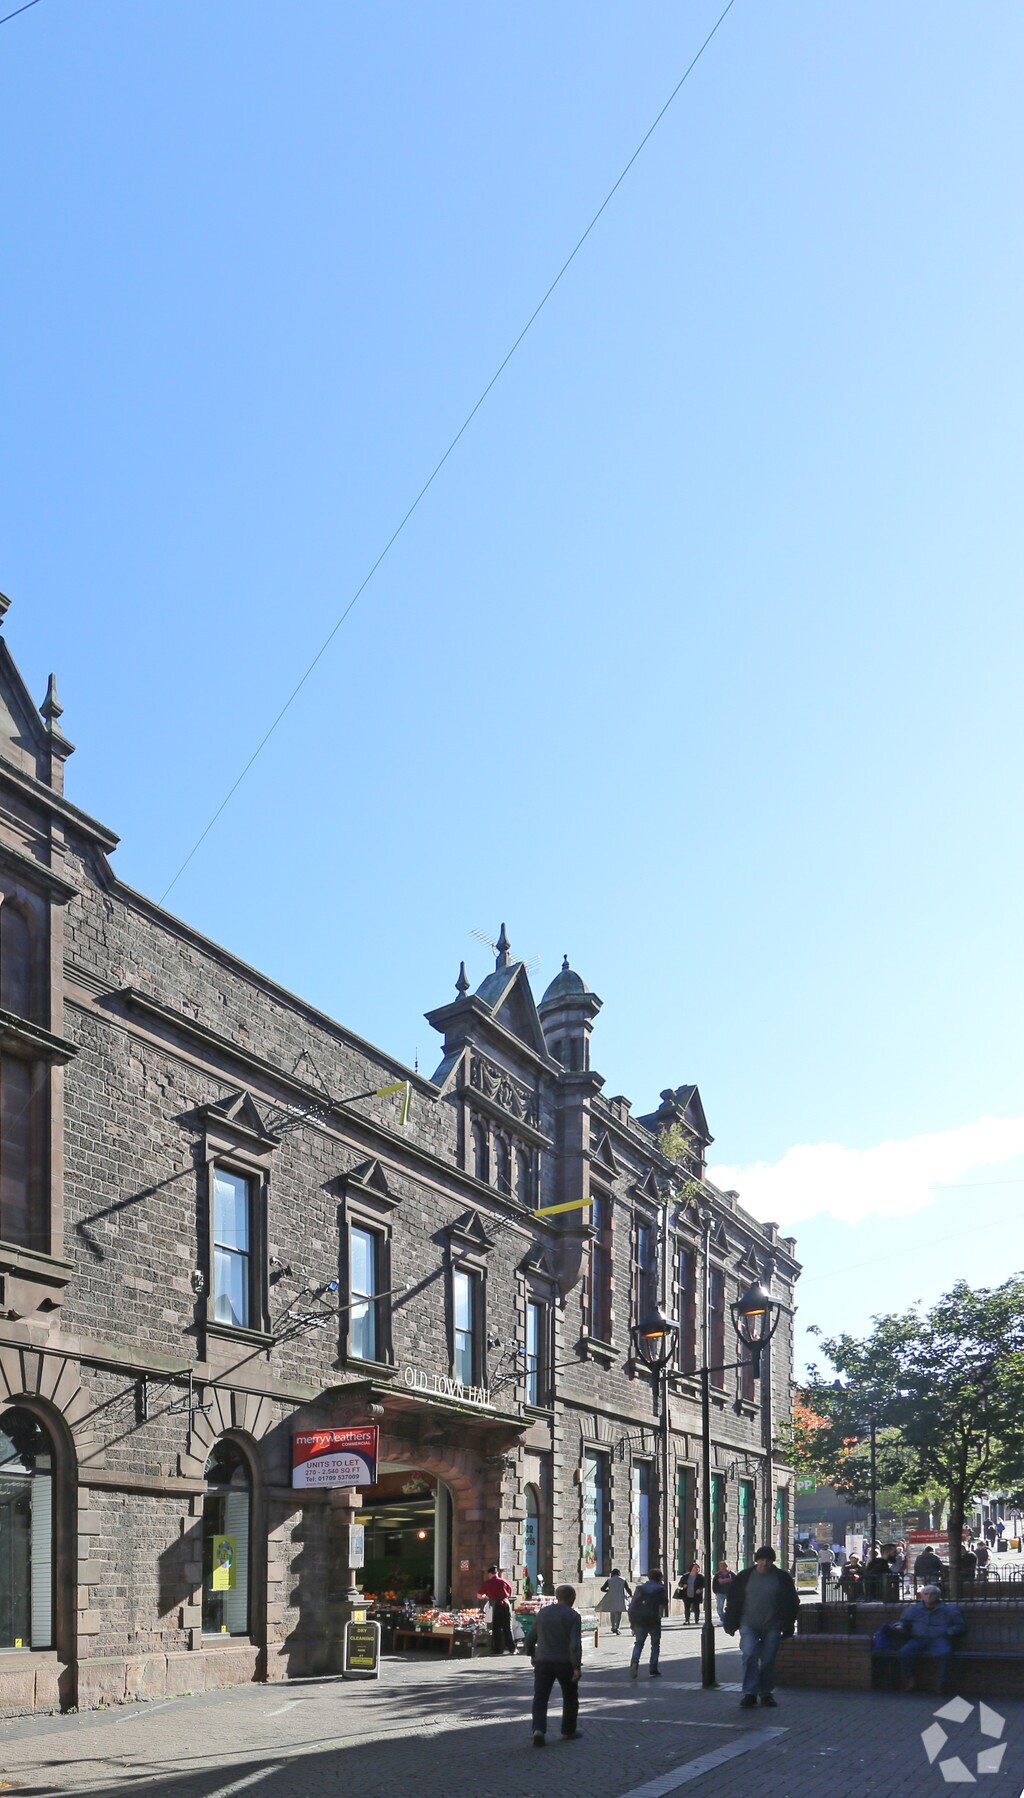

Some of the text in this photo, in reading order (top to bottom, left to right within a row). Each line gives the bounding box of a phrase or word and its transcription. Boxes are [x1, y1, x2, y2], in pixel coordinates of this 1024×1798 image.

[405, 1366, 491, 1406] OLD TOWN HALL
[296, 1431, 371, 1446] merryweathers
[344, 1459, 360, 1467] LET
